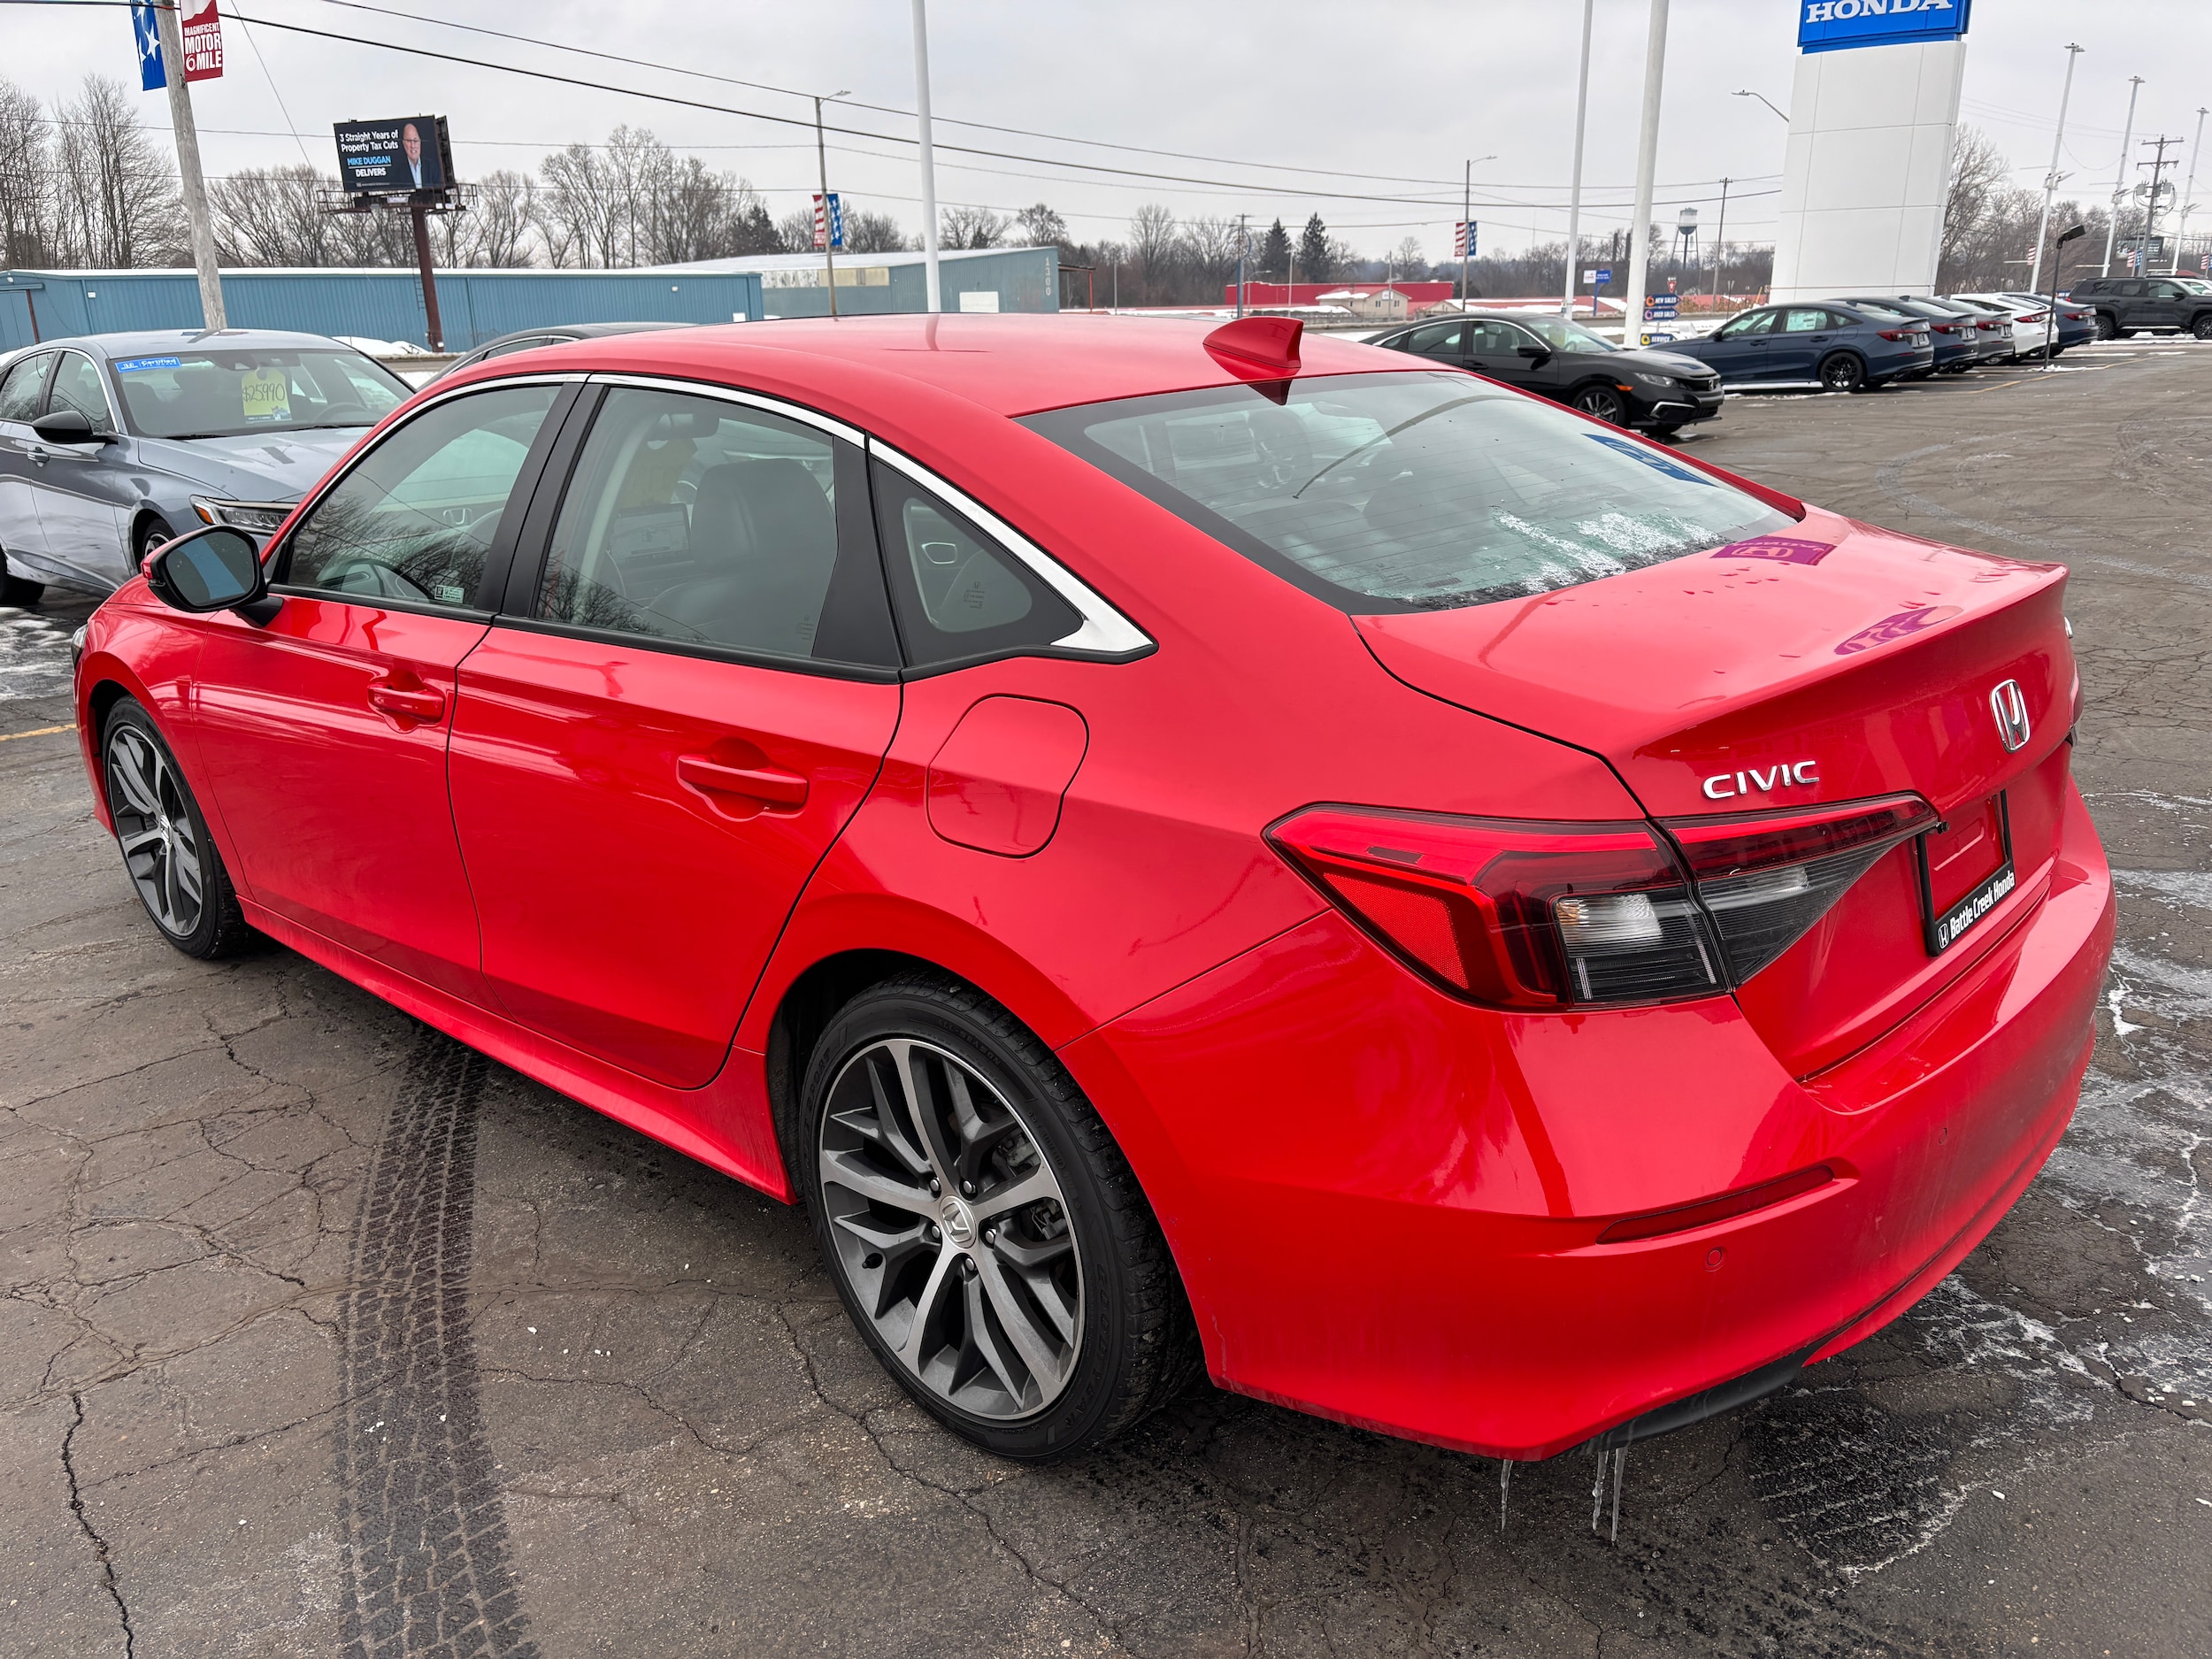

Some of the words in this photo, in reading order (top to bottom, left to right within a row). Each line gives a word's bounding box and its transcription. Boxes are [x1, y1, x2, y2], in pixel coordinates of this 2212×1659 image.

[184, 22, 219, 36] MAGNIFICENT
[184, 33, 222, 54] MOTOR
[196, 50, 222, 71] MILE
[340, 134, 344, 142] 3
[345, 132, 371, 142] Straight
[372, 131, 390, 140] Years
[391, 129, 398, 138] of
[342, 143, 369, 153] Property
[383, 141, 398, 150] Cuts
[347, 157, 363, 166] MIKE
[364, 156, 391, 165] DUGGAN
[356, 168, 386, 177] DELIVERS
[1702, 760, 1820, 799] CIVIC
[1949, 905, 1974, 940] Battle
[1973, 887, 1994, 919] Creek
[1993, 870, 2016, 902] Honda
